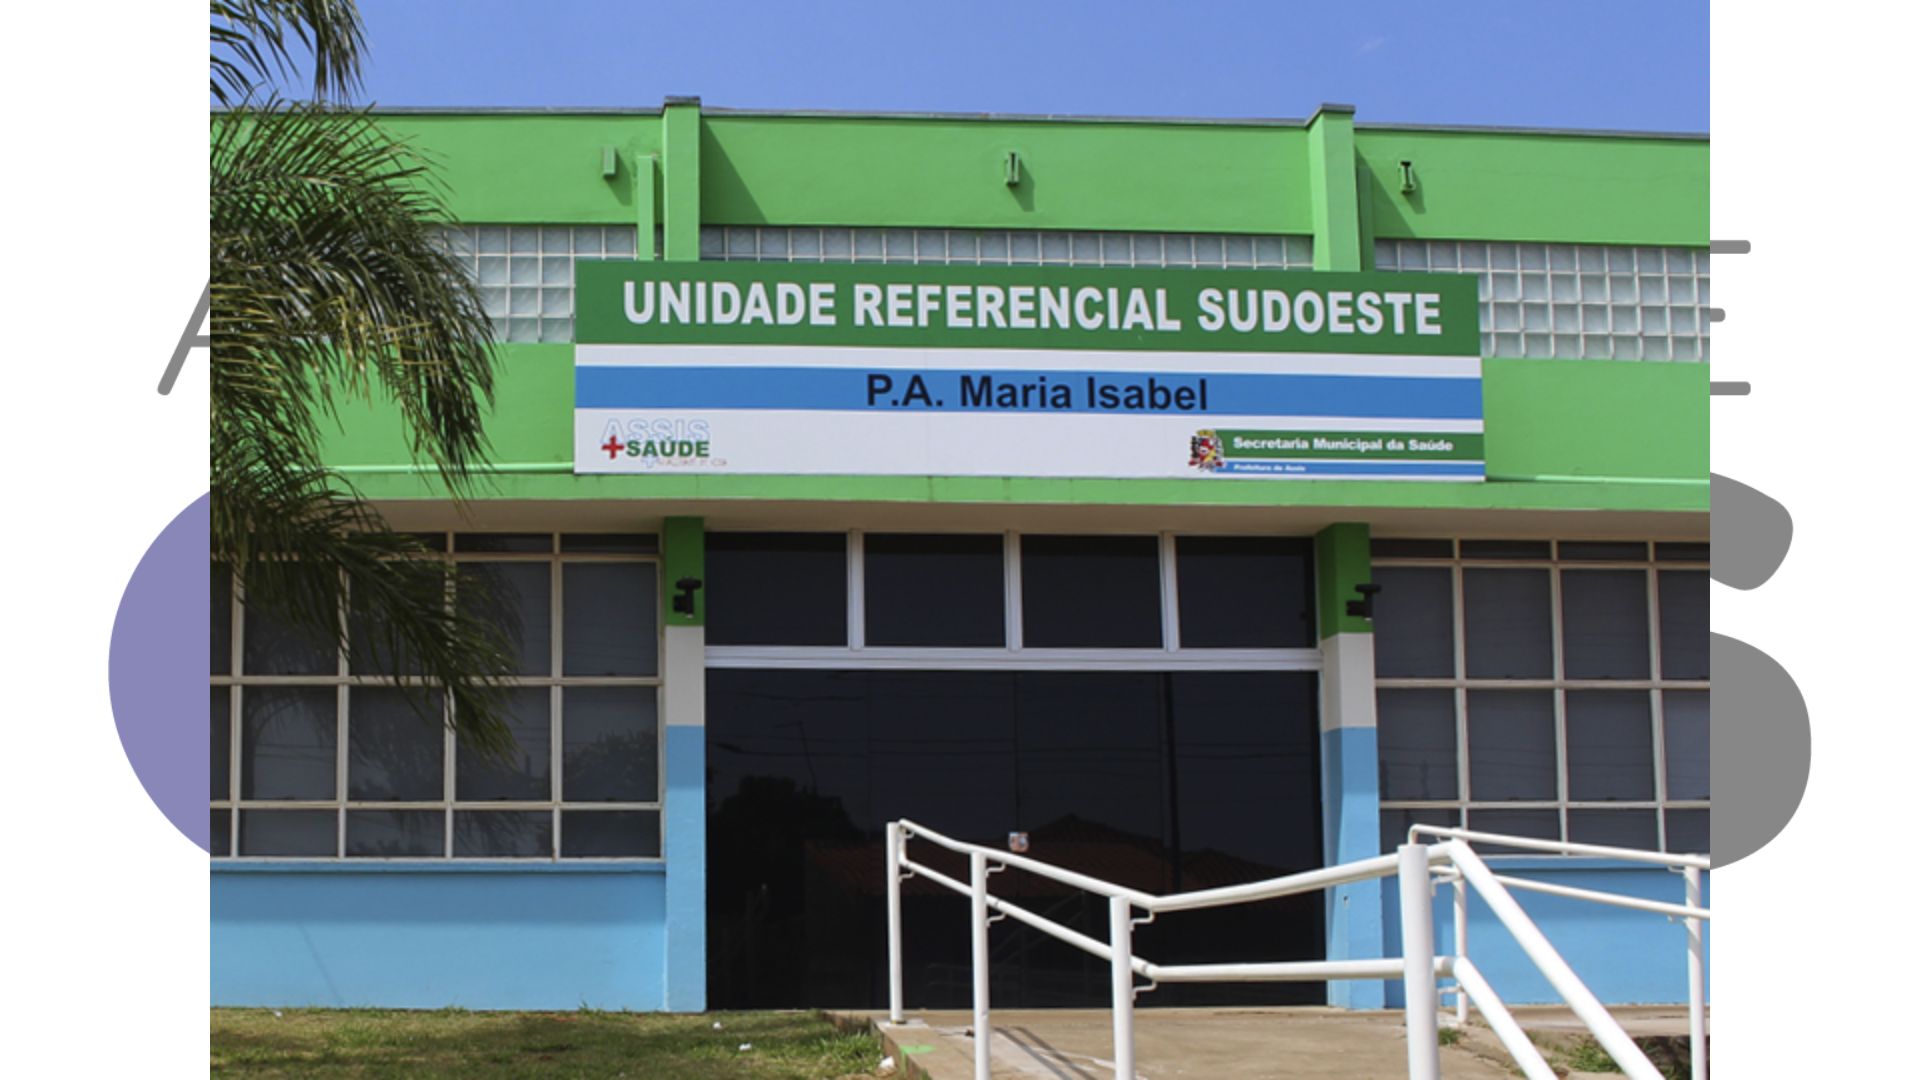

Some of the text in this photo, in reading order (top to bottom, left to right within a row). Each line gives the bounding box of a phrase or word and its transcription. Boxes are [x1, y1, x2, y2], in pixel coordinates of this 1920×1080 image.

[623, 280, 1443, 335] UNIDADE REFERENCIAL SUDOESTE
[866, 373, 1208, 411] P.A. Maria Isabel
[600, 418, 711, 443] ASSIS
[626, 435, 710, 457] SAÚDE
[1233, 436, 1454, 452] Secretaria Municipal da Saúde
